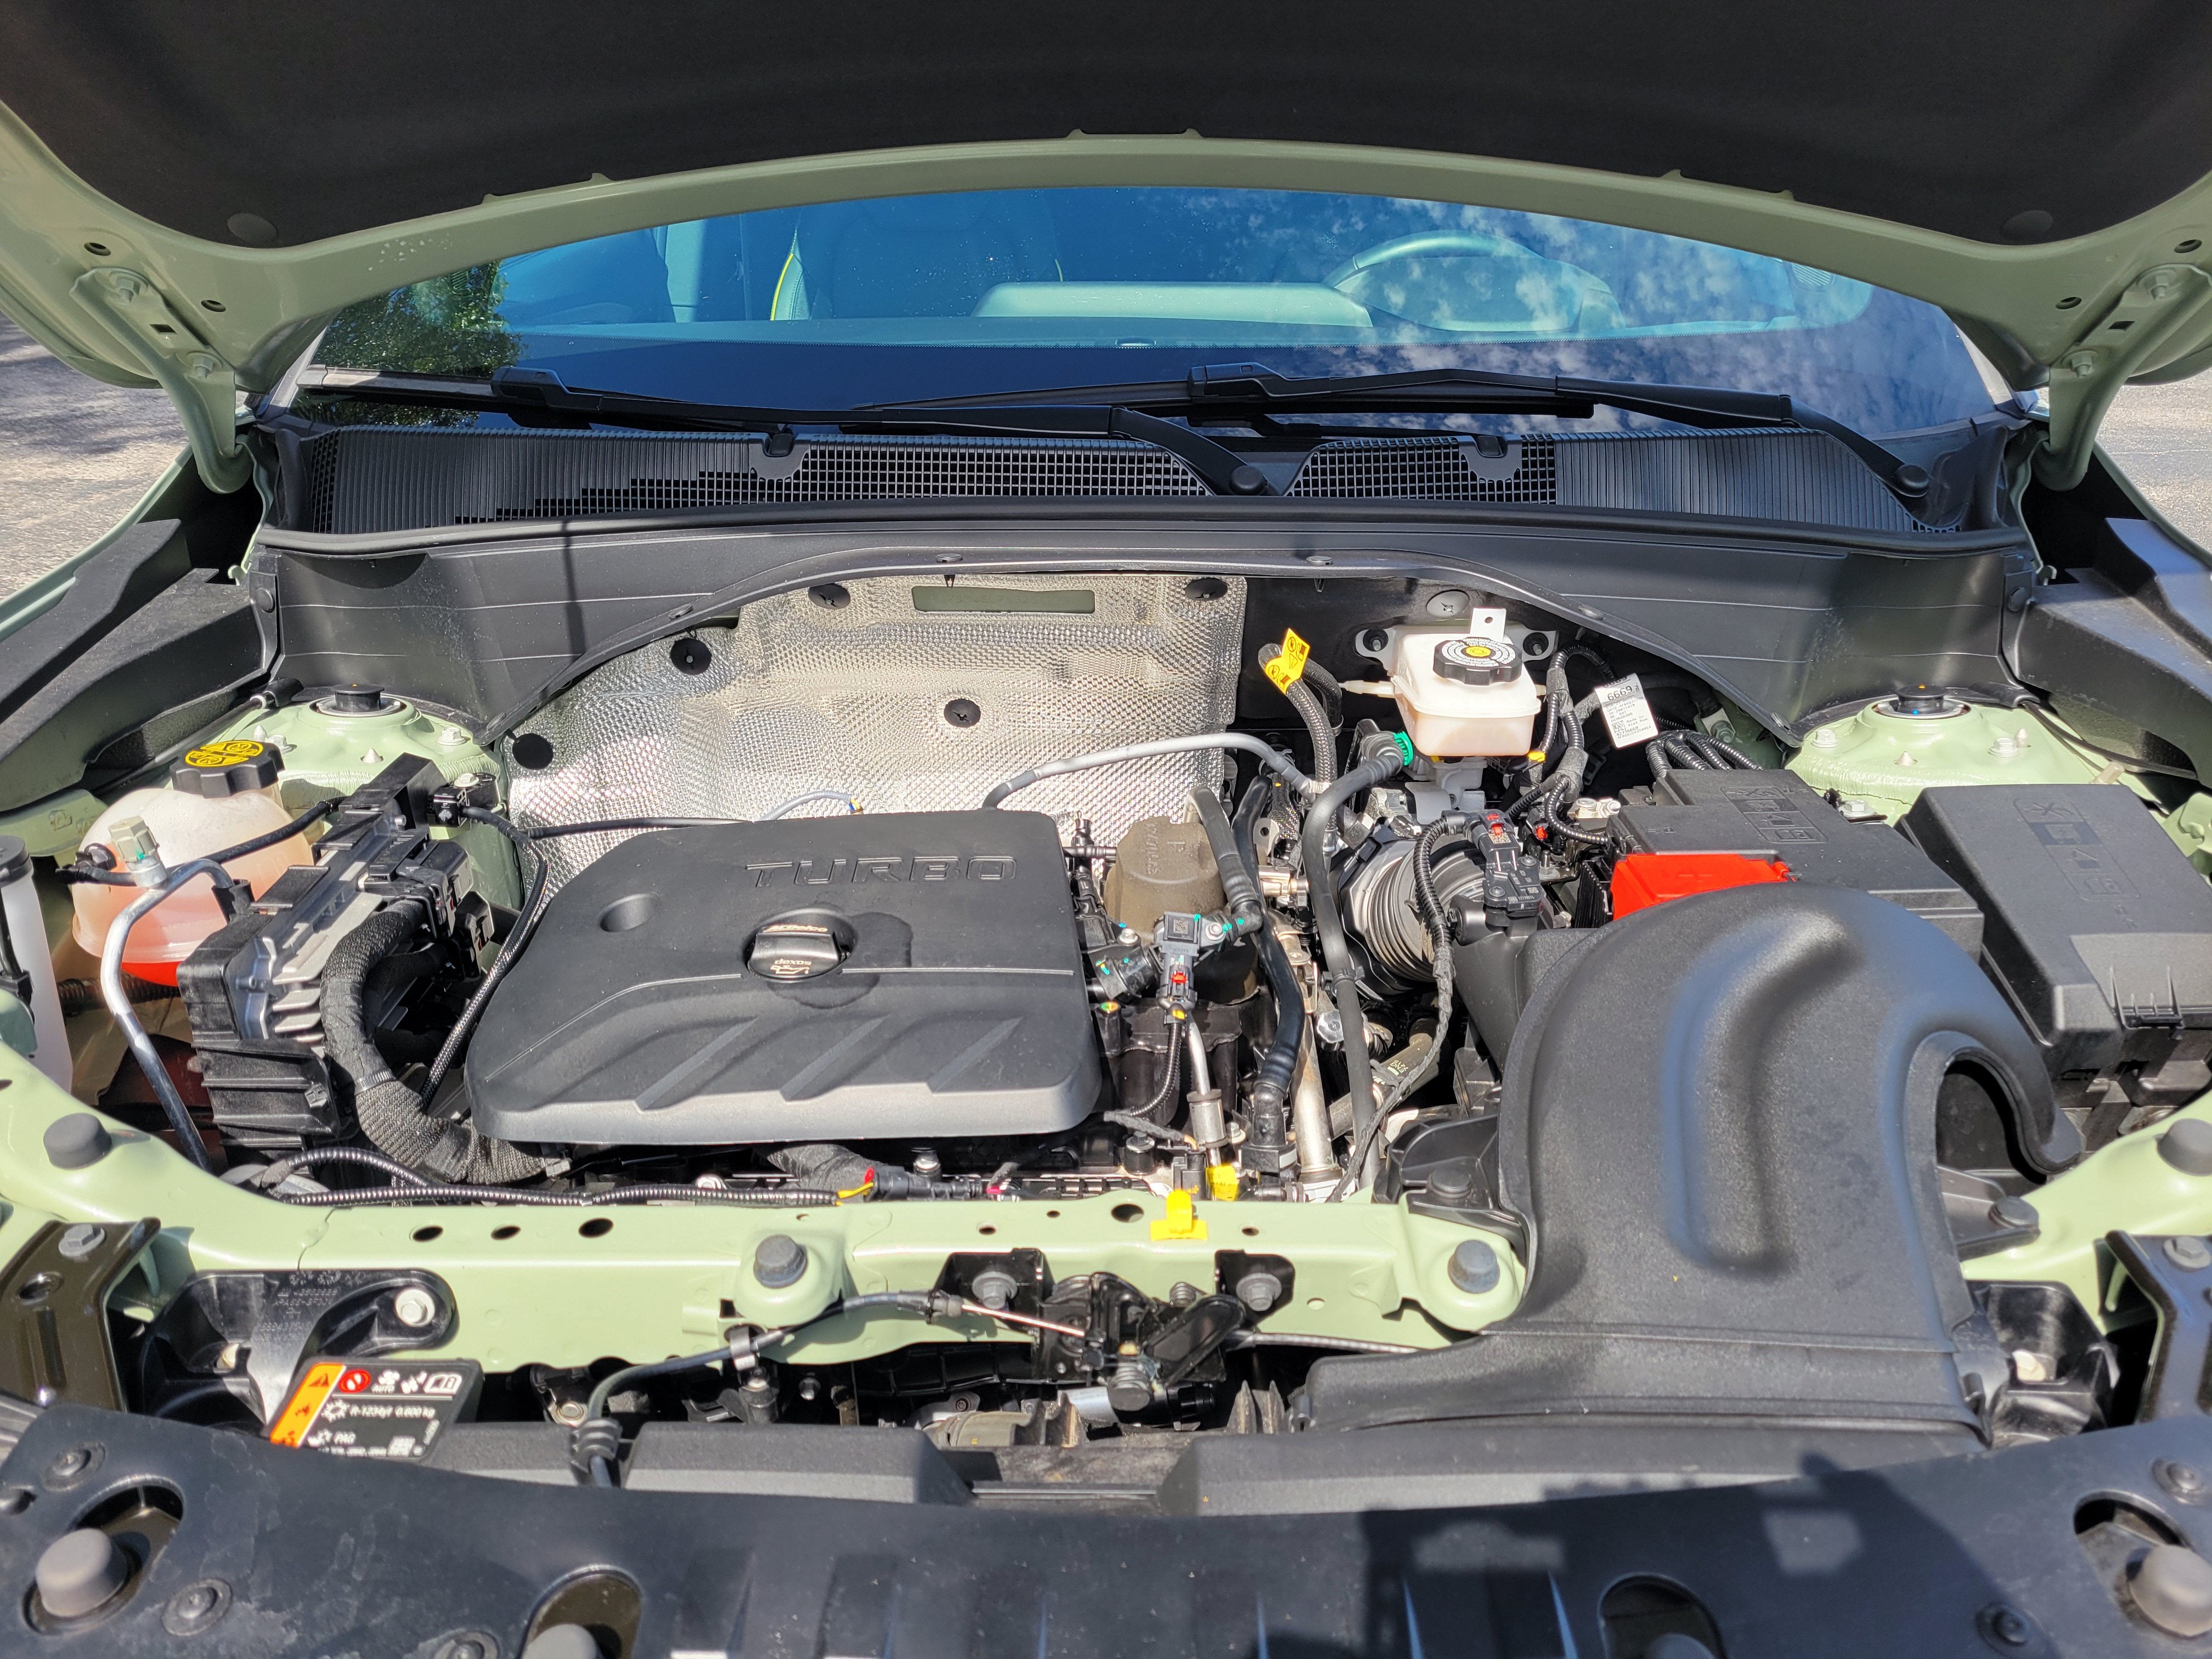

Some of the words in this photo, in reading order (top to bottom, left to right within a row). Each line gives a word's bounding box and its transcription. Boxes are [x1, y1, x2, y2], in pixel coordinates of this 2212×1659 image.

[1607, 686, 1633, 701] 6669
[746, 856, 1017, 888] TURBO
[763, 924, 828, 933] ACDelco
[371, 1385, 394, 1393] AUTO
[334, 1431, 356, 1445] PAG
